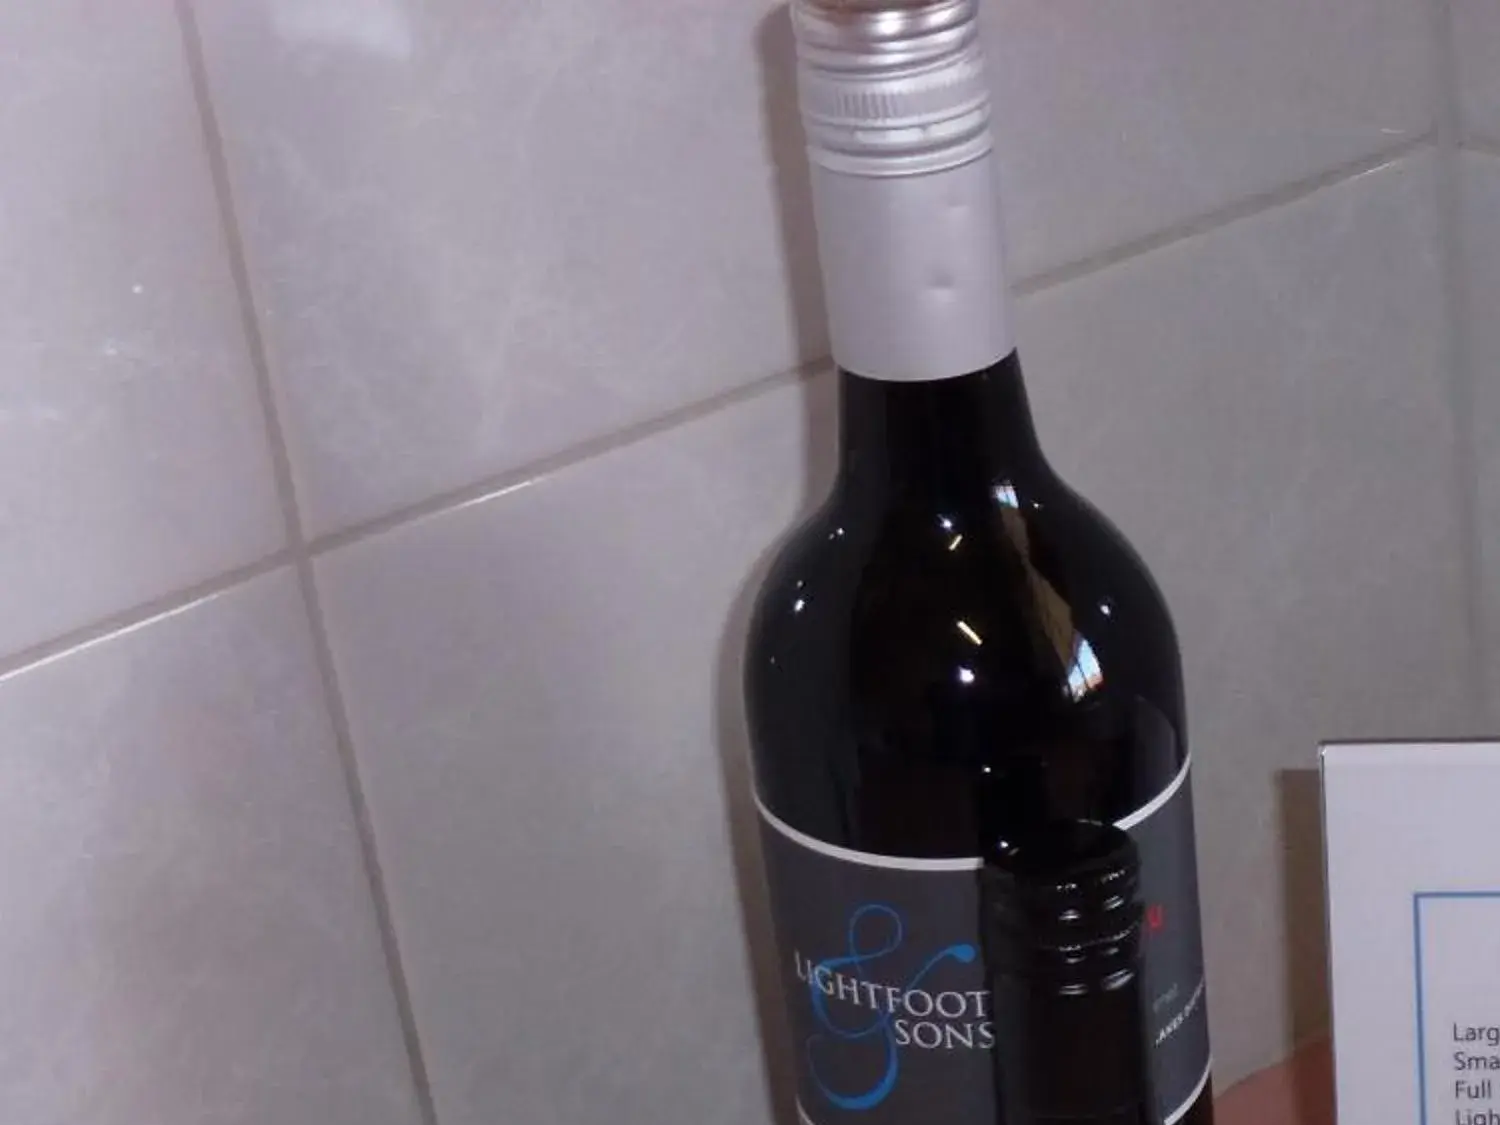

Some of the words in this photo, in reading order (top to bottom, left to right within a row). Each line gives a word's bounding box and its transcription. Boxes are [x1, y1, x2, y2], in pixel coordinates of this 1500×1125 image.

[794, 950, 991, 1019] LIGHTFOOT
[895, 1018, 996, 1049] SONS
[1456, 1080, 1491, 1099] Full
